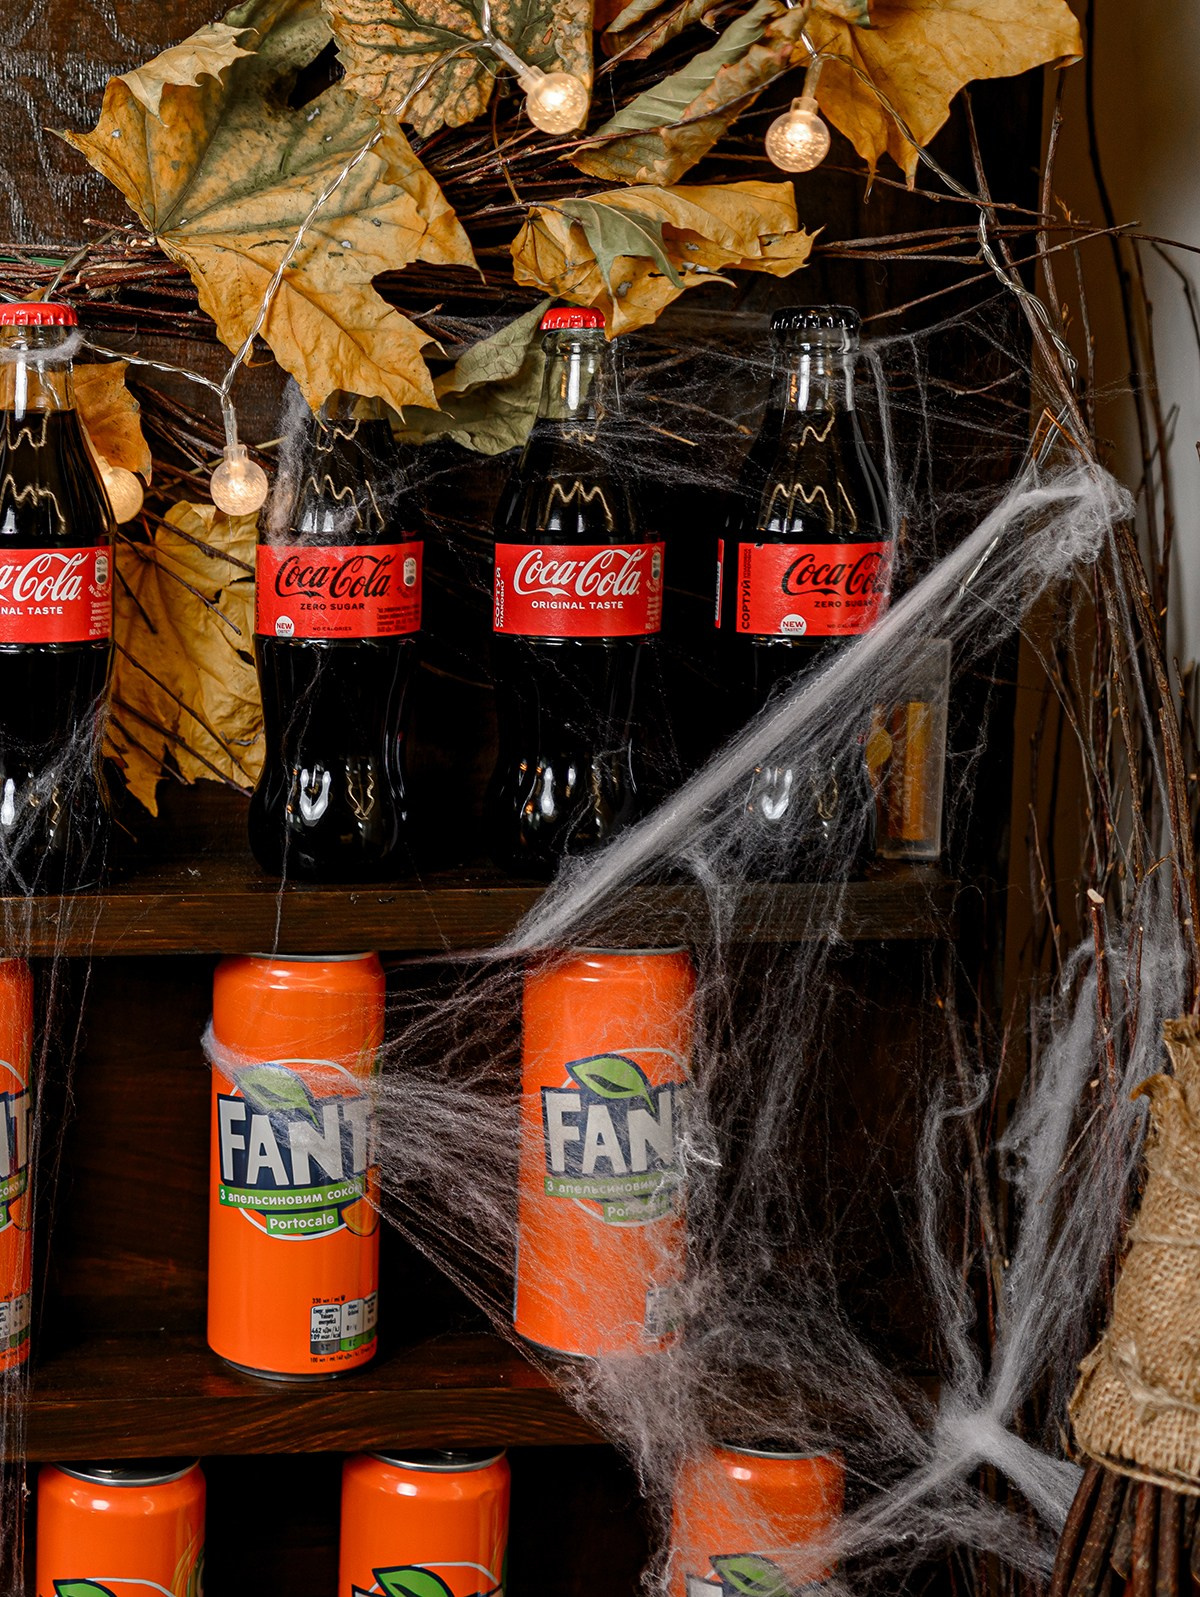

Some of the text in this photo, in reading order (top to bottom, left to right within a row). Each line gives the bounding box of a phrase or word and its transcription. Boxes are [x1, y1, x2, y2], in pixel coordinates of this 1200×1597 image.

[275, 554, 398, 600] Coca-Cola
[513, 548, 648, 598] Coca-Cola
[781, 551, 884, 597] Coca-Co
[27, 606, 64, 615] TASTE
[300, 602, 366, 611] ZERO SUGAR
[531, 600, 624, 610] ORIGINAL TASTE
[741, 580, 751, 630] СОРТУЙ
[276, 622, 293, 630] NEW
[782, 620, 805, 629] NEW
[219, 1098, 372, 1187] FANT
[228, 1192, 323, 1207] апельсиновим
[269, 1213, 335, 1231] Portocale
